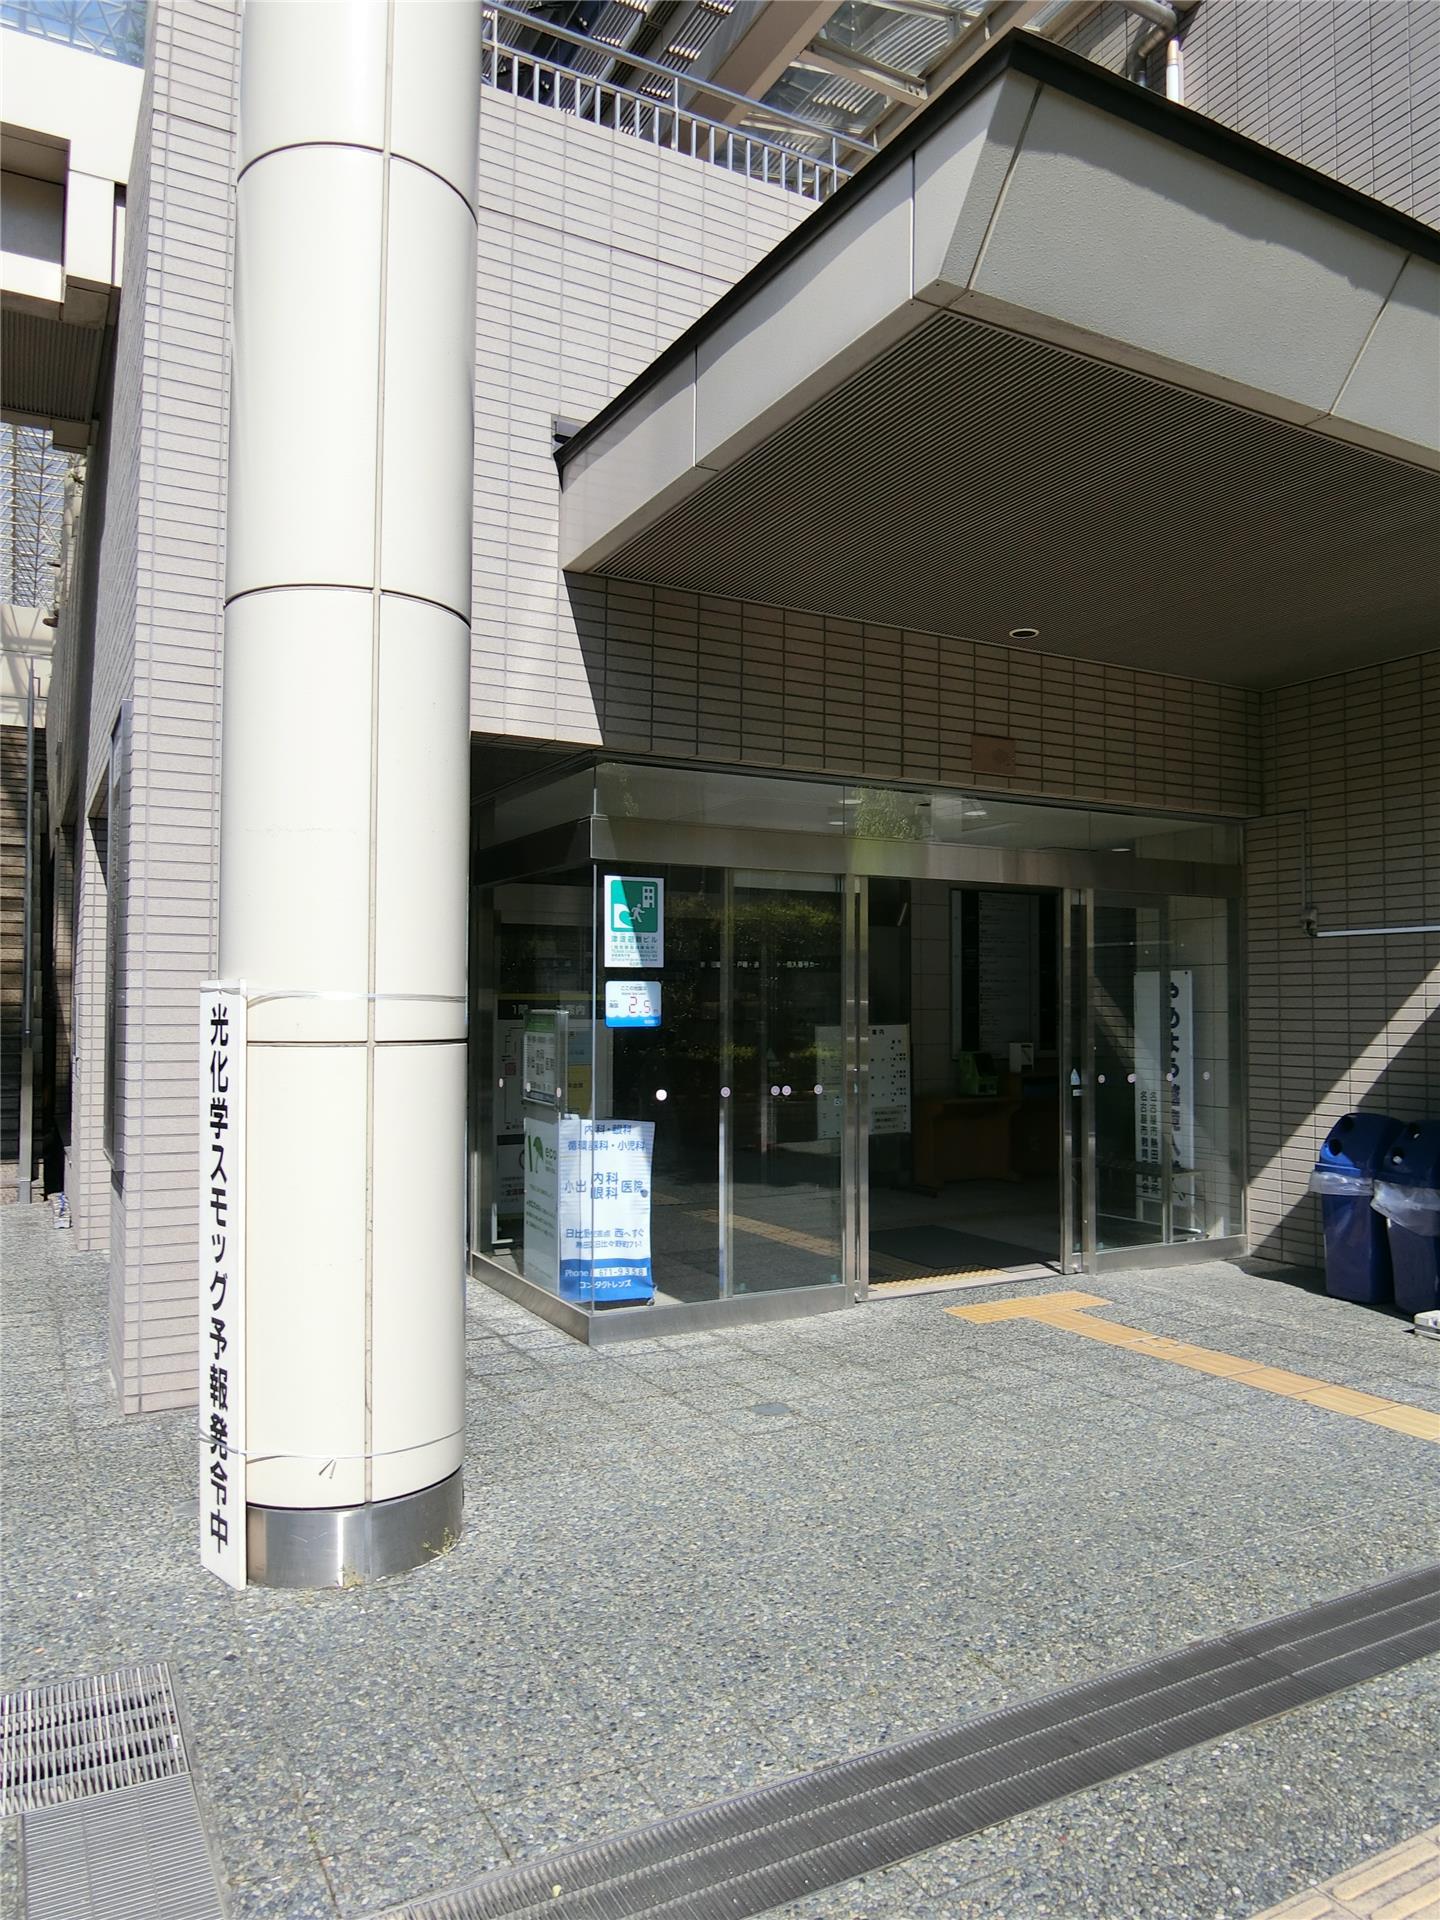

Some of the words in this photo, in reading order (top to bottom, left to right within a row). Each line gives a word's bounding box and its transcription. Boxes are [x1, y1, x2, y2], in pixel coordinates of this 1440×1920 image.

[628, 996, 651, 1014] 2.5
[584, 1123, 632, 1135] 内科・眼科
[592, 1171, 618, 1185] 内科
[564, 1179, 587, 1193] 小出
[591, 1186, 618, 1200] 眼科
[621, 1179, 644, 1193] 医院
[208, 1003, 231, 1556] 光化学スモッグ予報発令中
[579, 1279, 632, 1289] コンタクトレンズ
